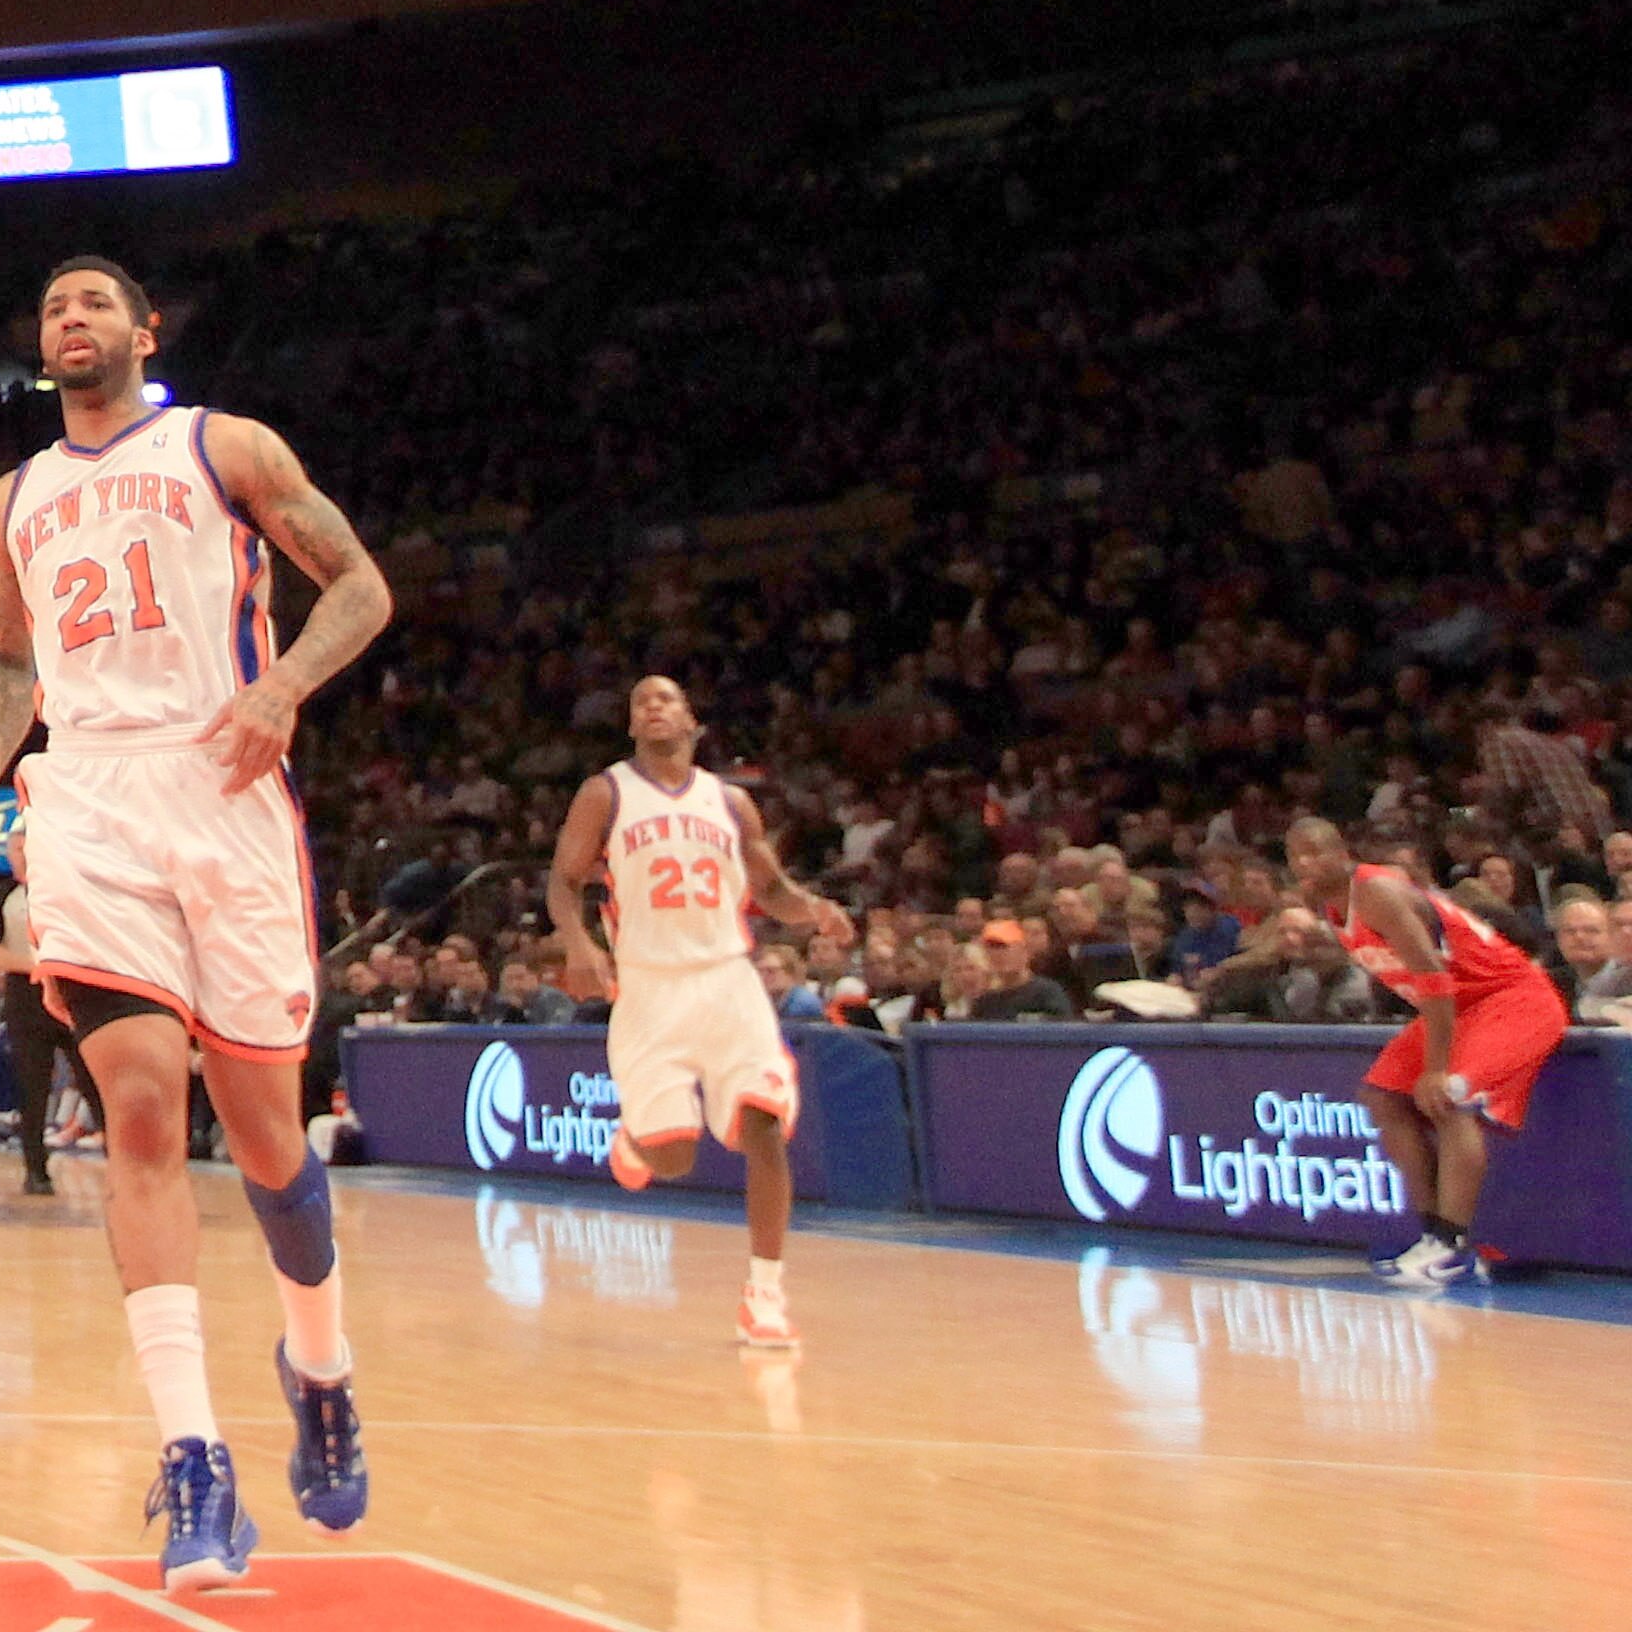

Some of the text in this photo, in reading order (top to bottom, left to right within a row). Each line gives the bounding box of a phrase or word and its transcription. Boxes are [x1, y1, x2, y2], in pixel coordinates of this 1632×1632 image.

[15, 472, 194, 576] NEW YORK
[52, 540, 166, 653] 21
[623, 815, 735, 859] NEW YORK
[649, 856, 721, 909] 23
[1255, 1091, 1377, 1141] Optimu
